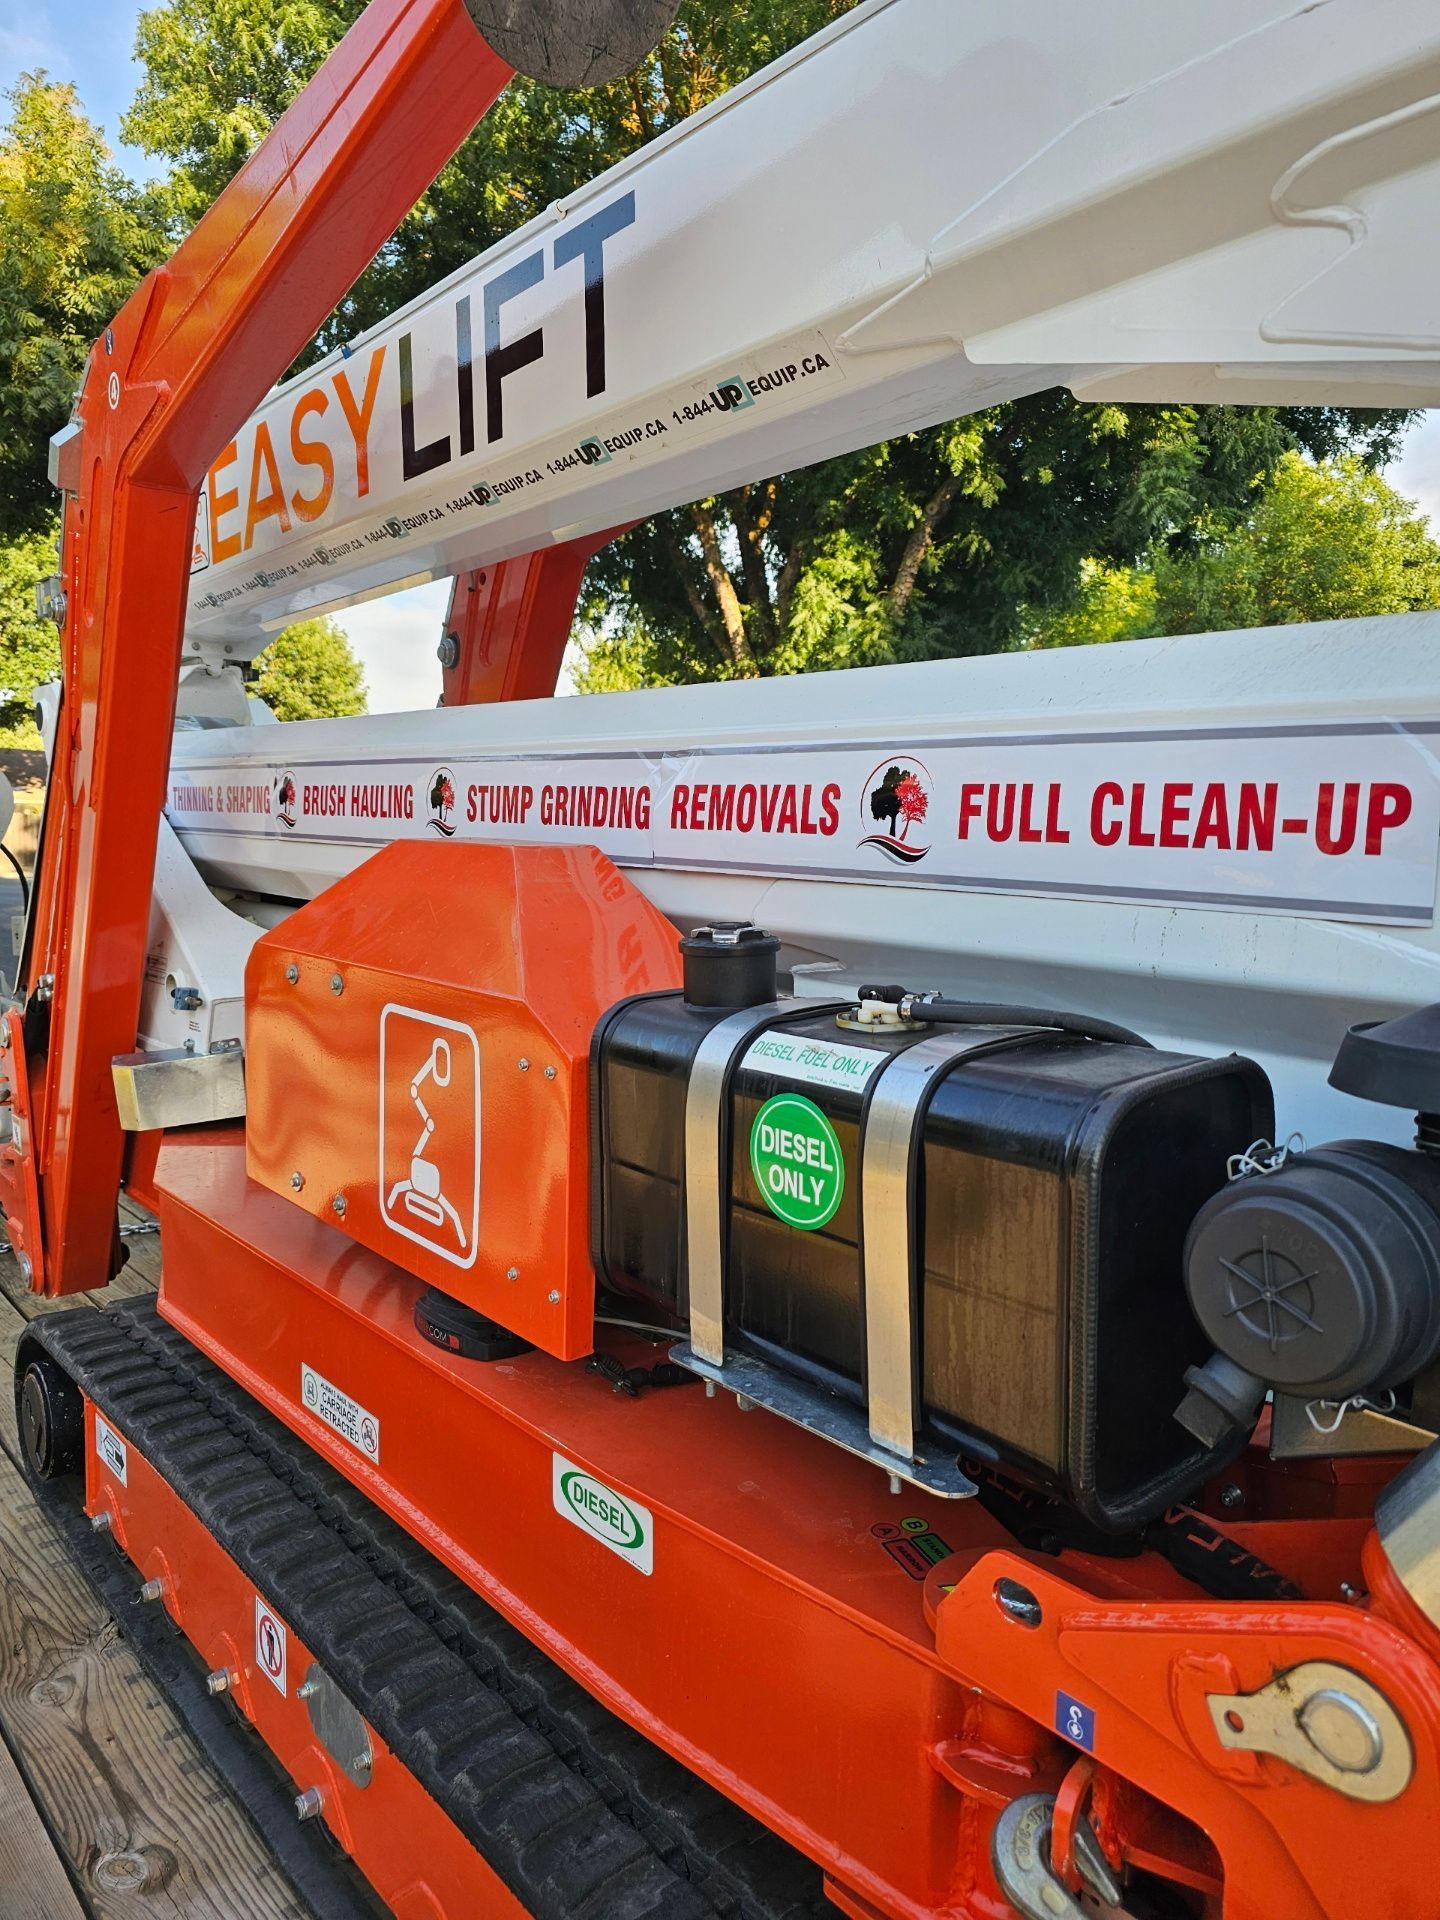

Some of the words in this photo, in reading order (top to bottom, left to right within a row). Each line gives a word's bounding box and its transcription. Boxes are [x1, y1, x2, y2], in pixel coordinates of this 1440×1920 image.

[173, 785, 213, 812] THINNING
[217, 786, 223, 812] &
[227, 786, 270, 814] SHAPING
[303, 785, 346, 816] BRUSH
[351, 784, 413, 819] HAULING
[467, 784, 533, 824] STUMP
[540, 784, 650, 830] GRINDING
[671, 783, 841, 836] REMOVALS
[958, 783, 1070, 843] FULL
[1090, 781, 1412, 856] CLEAN-UP
[752, 1041, 796, 1061] DIESEL
[796, 1048, 830, 1068] FUEL
[832, 1056, 874, 1076] ONLY
[761, 1124, 833, 1172] DIESEL
[769, 1164, 825, 1206] ONLY
[320, 1404, 360, 1443] RETRACTED
[322, 1391, 357, 1427] CARRIAGE
[573, 1481, 630, 1538] DIESEL
